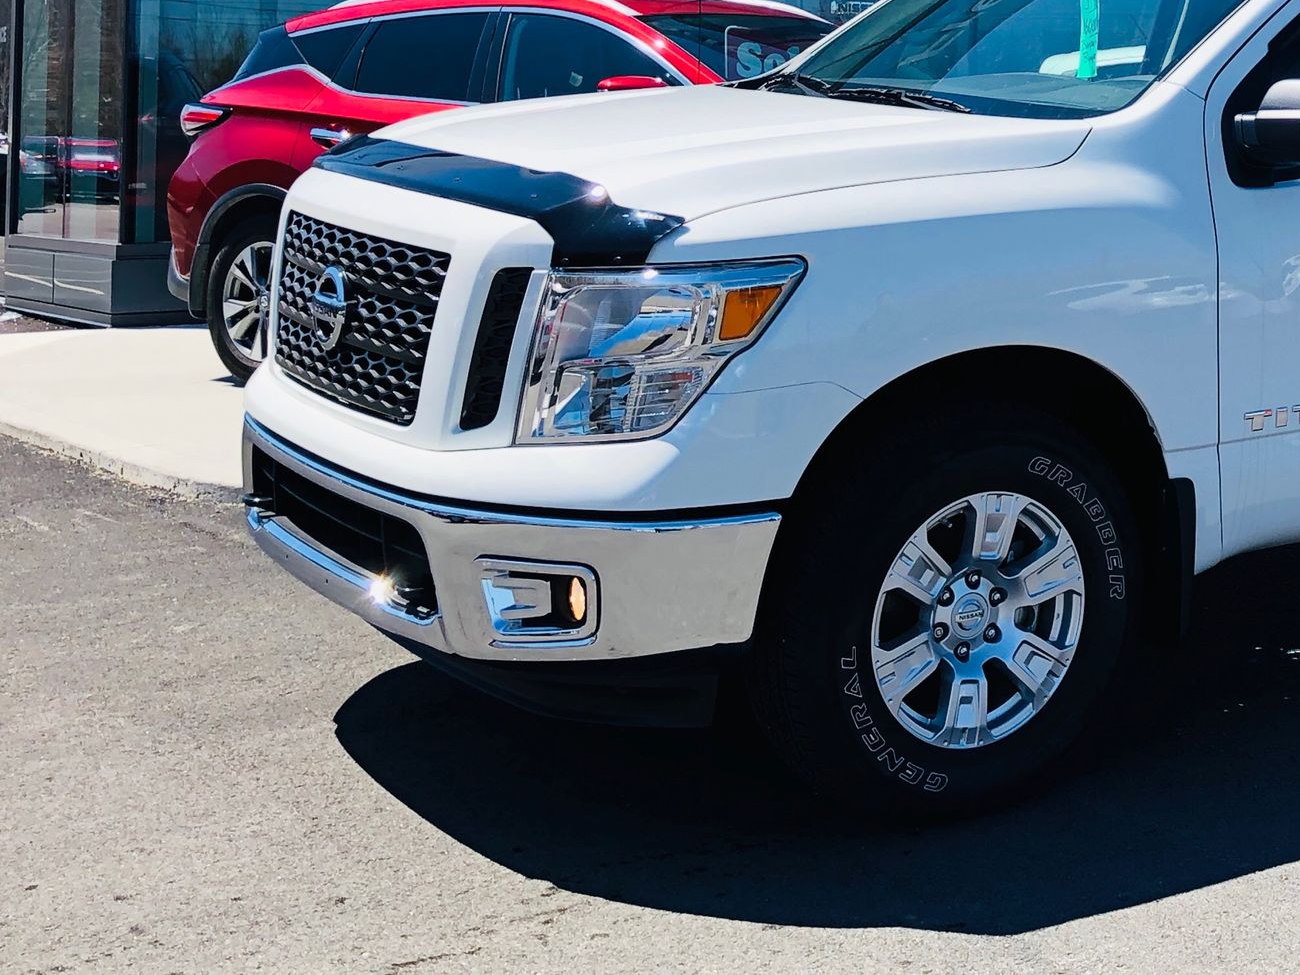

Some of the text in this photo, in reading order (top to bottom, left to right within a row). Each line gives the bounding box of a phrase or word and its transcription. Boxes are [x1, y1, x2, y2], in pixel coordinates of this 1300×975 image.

[1027, 455, 1126, 600] GRABBER
[959, 611, 984, 620] NISSAN
[840, 645, 949, 793] GENERAL
